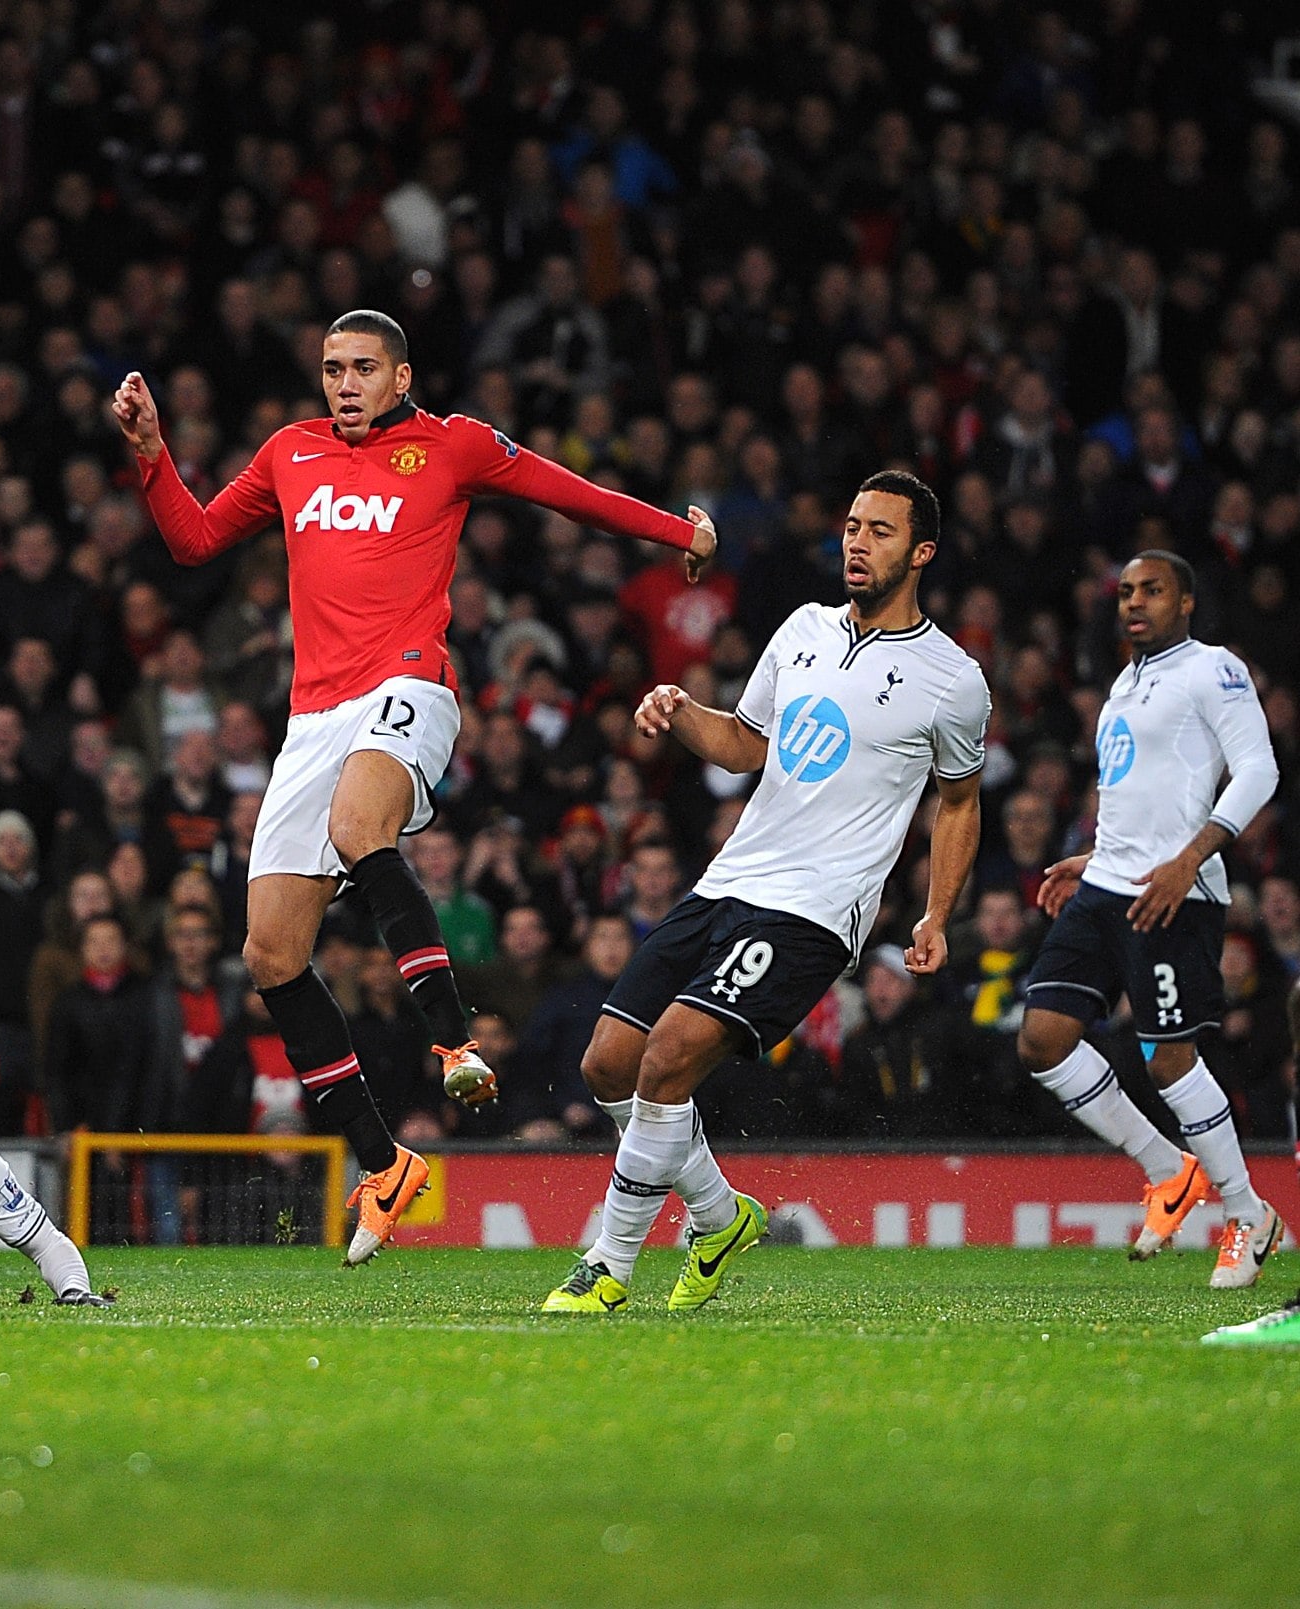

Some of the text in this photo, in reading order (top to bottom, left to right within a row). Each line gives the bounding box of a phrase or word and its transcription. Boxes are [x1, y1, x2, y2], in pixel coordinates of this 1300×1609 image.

[377, 695, 417, 738] 12
[779, 695, 850, 783] hp
[1098, 716, 1134, 787] hp
[713, 936, 774, 988] 19
[1153, 962, 1179, 1009] 3
